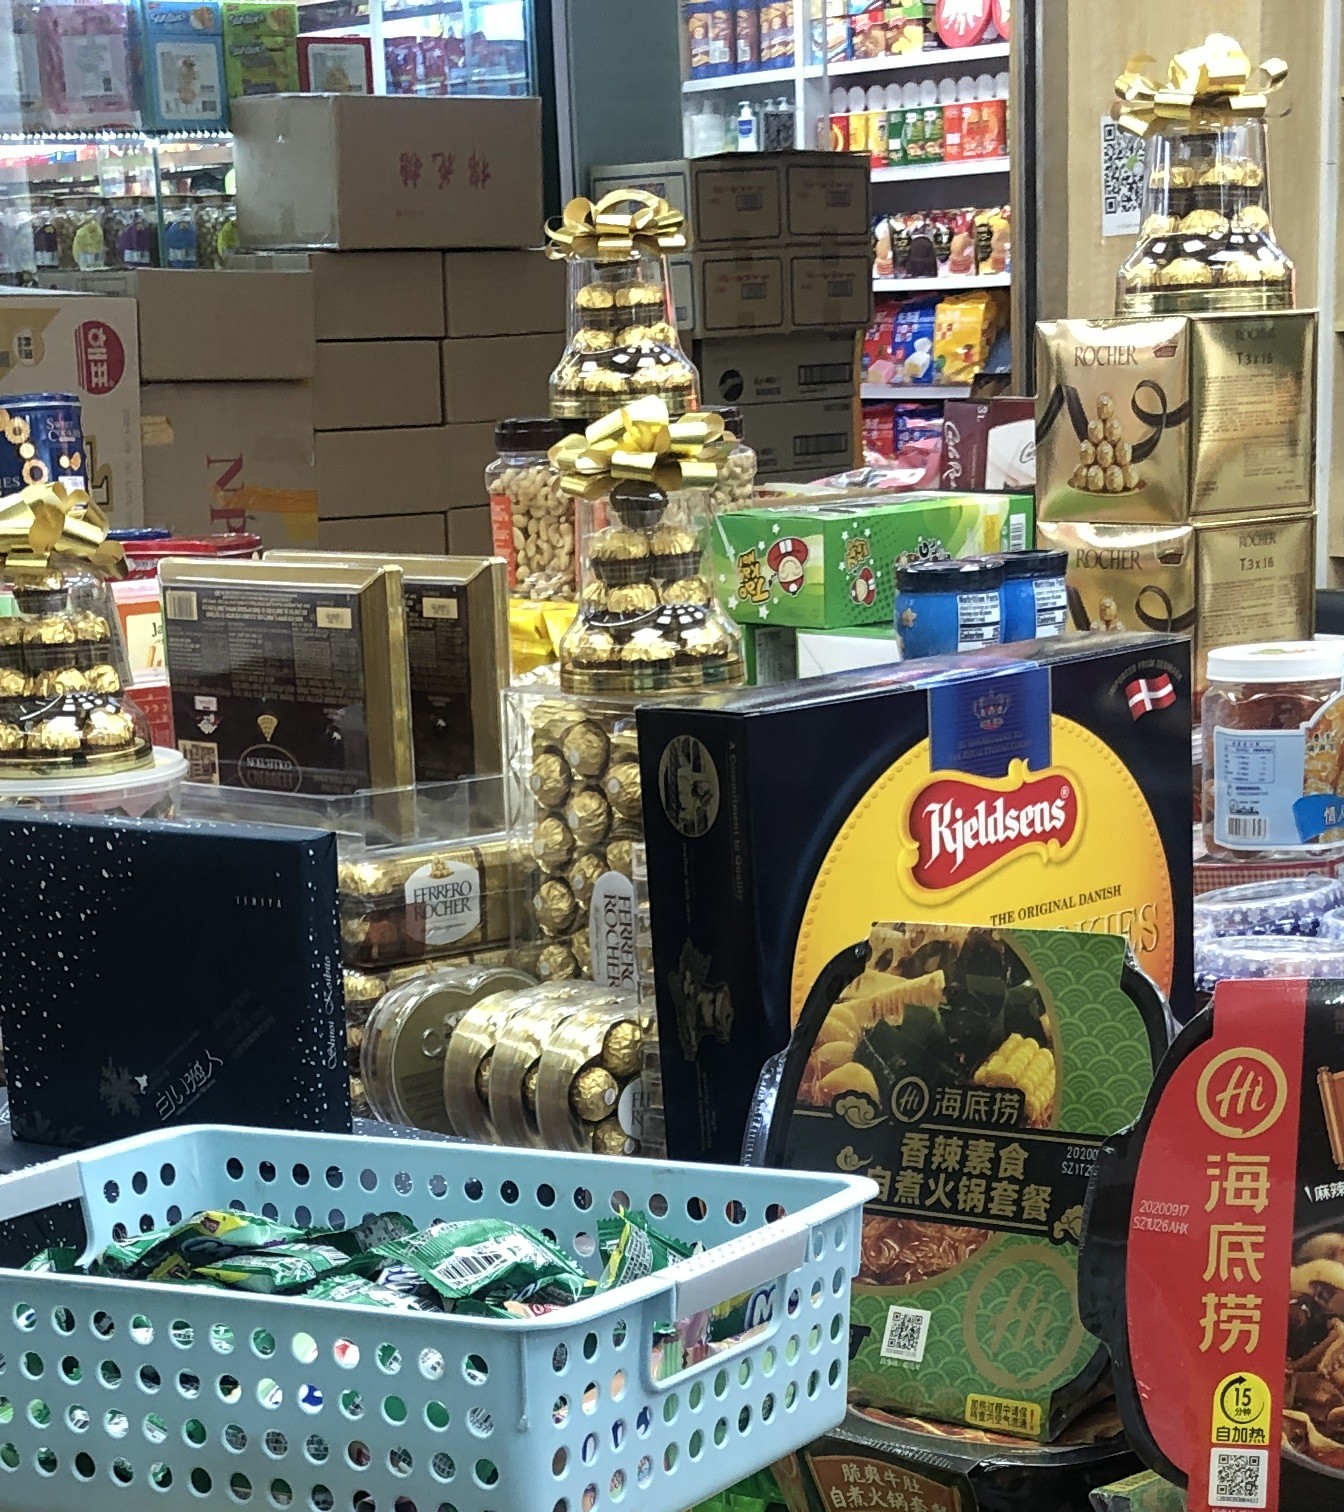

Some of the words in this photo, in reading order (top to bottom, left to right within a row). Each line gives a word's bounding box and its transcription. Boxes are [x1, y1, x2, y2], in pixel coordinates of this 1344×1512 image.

[1074, 346, 1139, 367] ROCHER
[1075, 549, 1142, 571] ROCHER
[923, 793, 1066, 874] Kjeldsens
[413, 880, 474, 903] FERRERO
[990, 911, 1015, 928] THE
[1017, 897, 1076, 924] ORIGINAL
[1077, 884, 1123, 912] DANISH
[413, 898, 474, 922] ROCHER
[933, 1087, 1021, 1126] 海底捞
[900, 1132, 1030, 1181] 香辣素食
[865, 1166, 1053, 1222] 自煮火锅套餐
[1197, 1152, 1272, 1356] 海底捞
[1234, 1387, 1252, 1408] 15
[1215, 1425, 1266, 1444] 自加热
[842, 1461, 924, 1497] 脆爽牛肚
